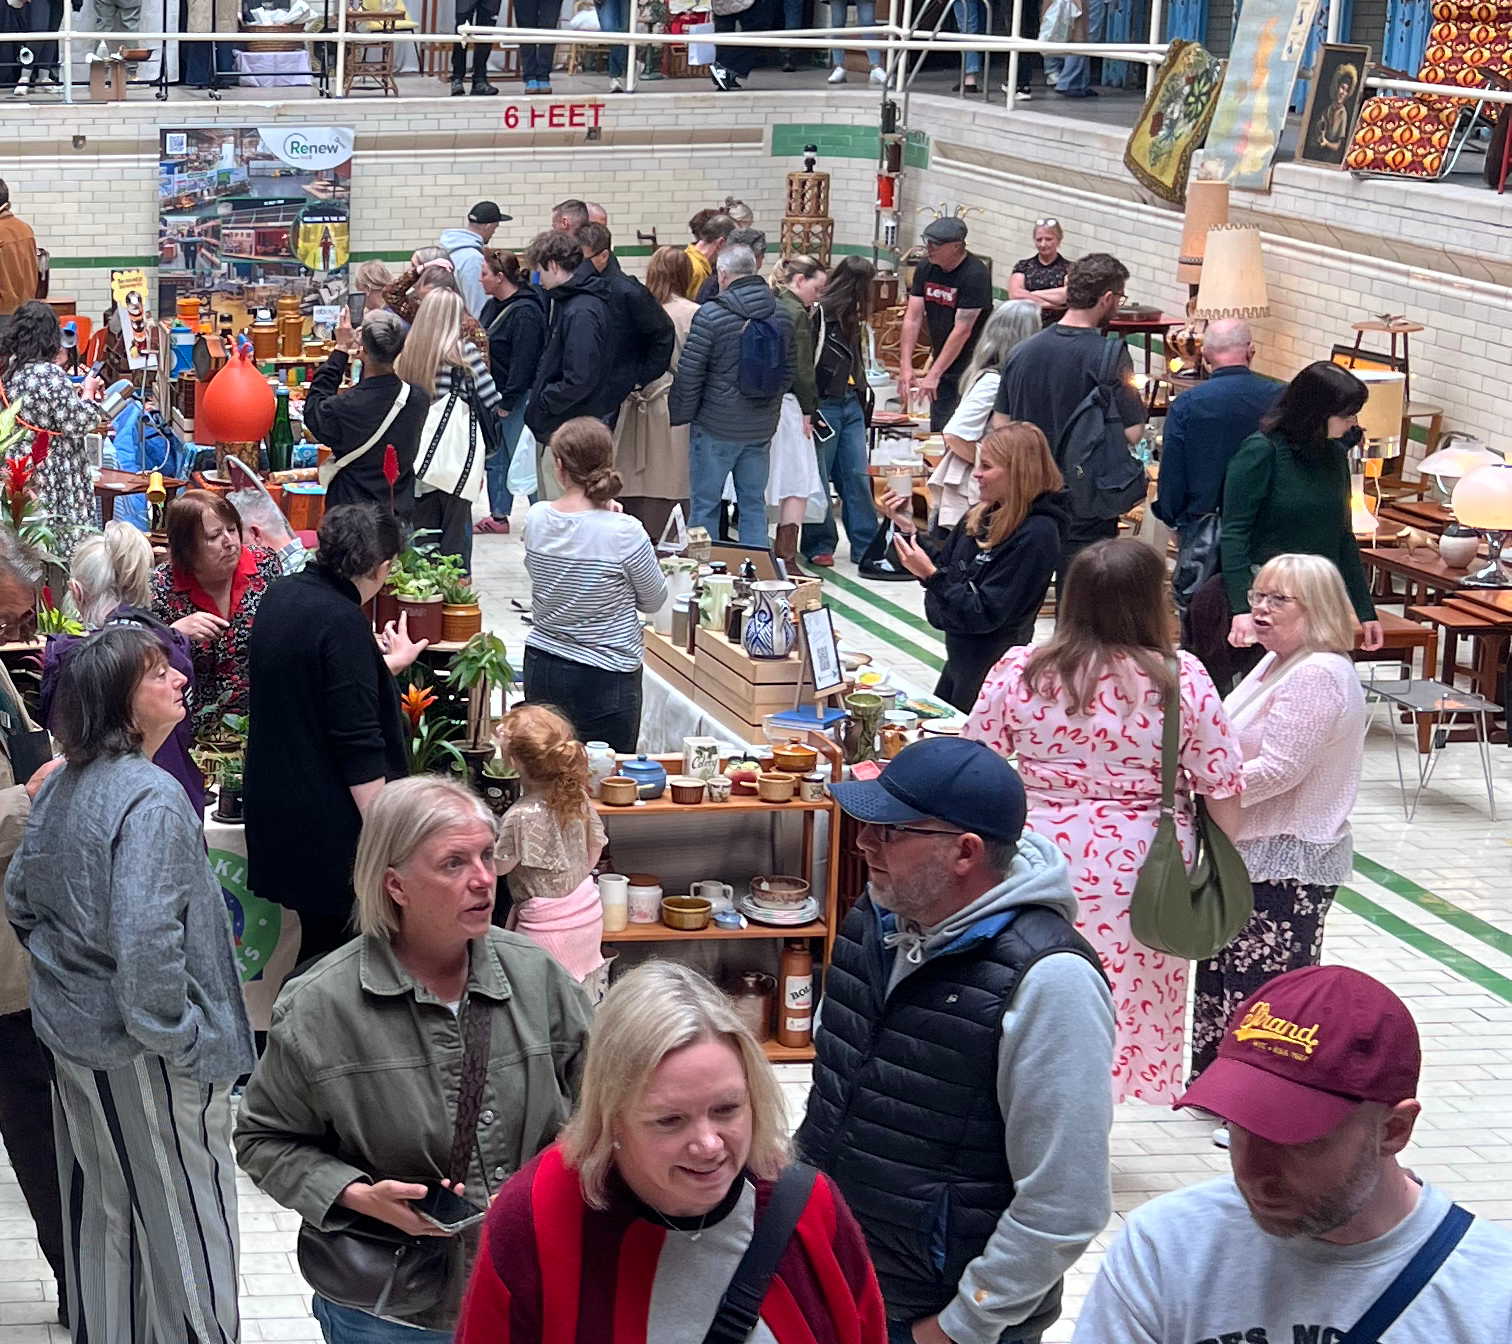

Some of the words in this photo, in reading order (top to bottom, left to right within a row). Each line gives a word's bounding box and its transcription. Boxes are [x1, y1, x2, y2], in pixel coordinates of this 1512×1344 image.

[504, 105, 519, 129] 6
[529, 103, 606, 129] FEET
[290, 140, 339, 155] Renew
[691, 755, 718, 774] Celery
